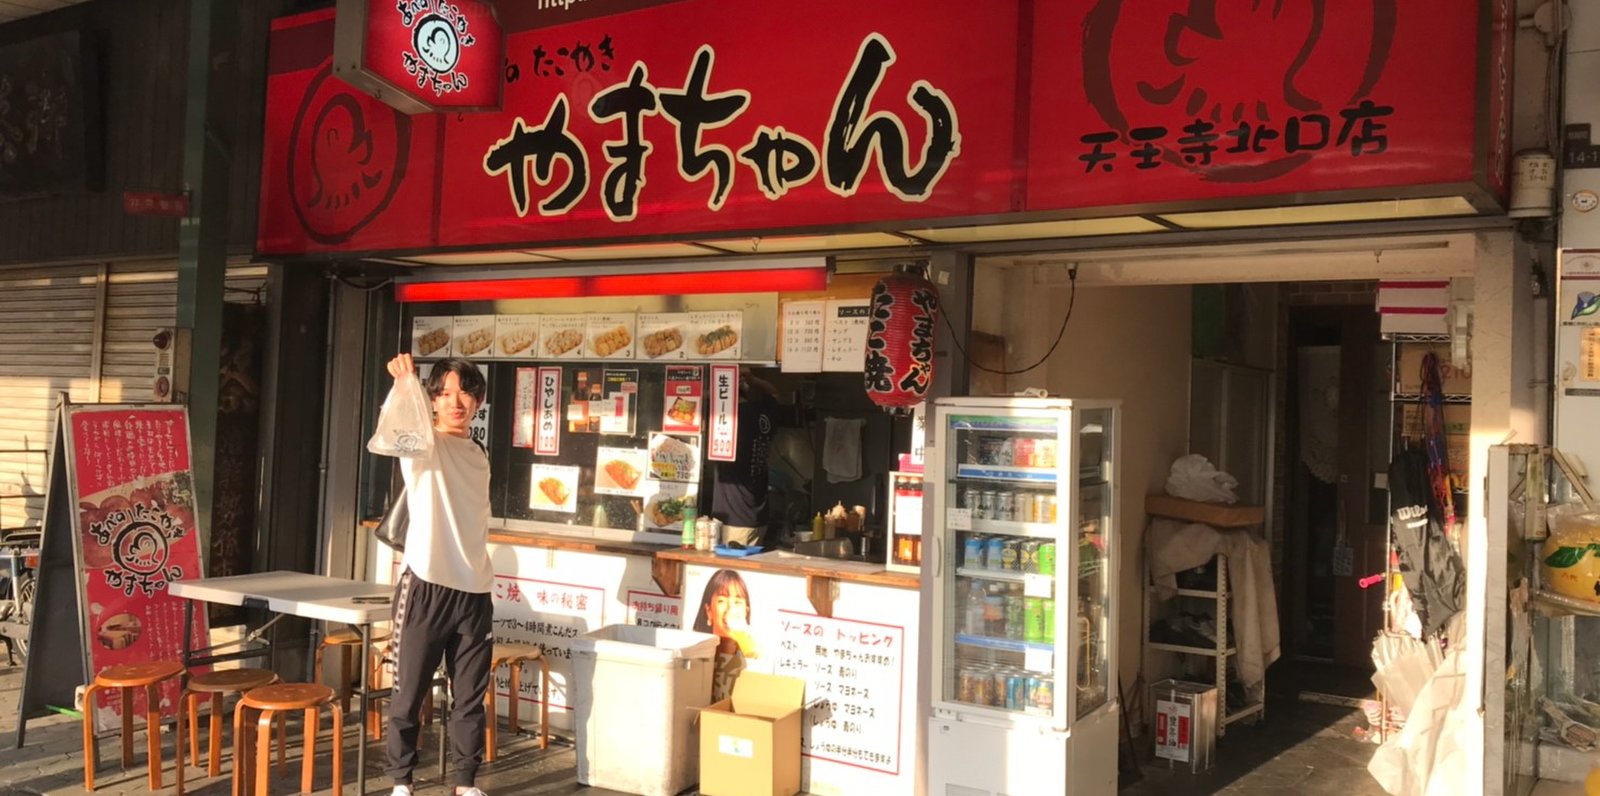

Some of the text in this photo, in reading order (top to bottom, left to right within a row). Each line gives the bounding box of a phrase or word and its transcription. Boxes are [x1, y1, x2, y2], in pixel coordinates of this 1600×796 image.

[402, 51, 468, 96] やまちゃん
[533, 34, 614, 77] たこやき
[483, 32, 962, 221] やまちゃん
[1078, 100, 1394, 173] 天王寺北口店
[898, 288, 937, 396] やまちゃん
[543, 376, 555, 431] ひやしあめ
[718, 374, 729, 426] 生ビール
[89, 503, 185, 545] あべの たこやき
[104, 565, 183, 597] やまちゃん
[536, 589, 588, 611] 味の秘密
[781, 620, 824, 637] ソースの
